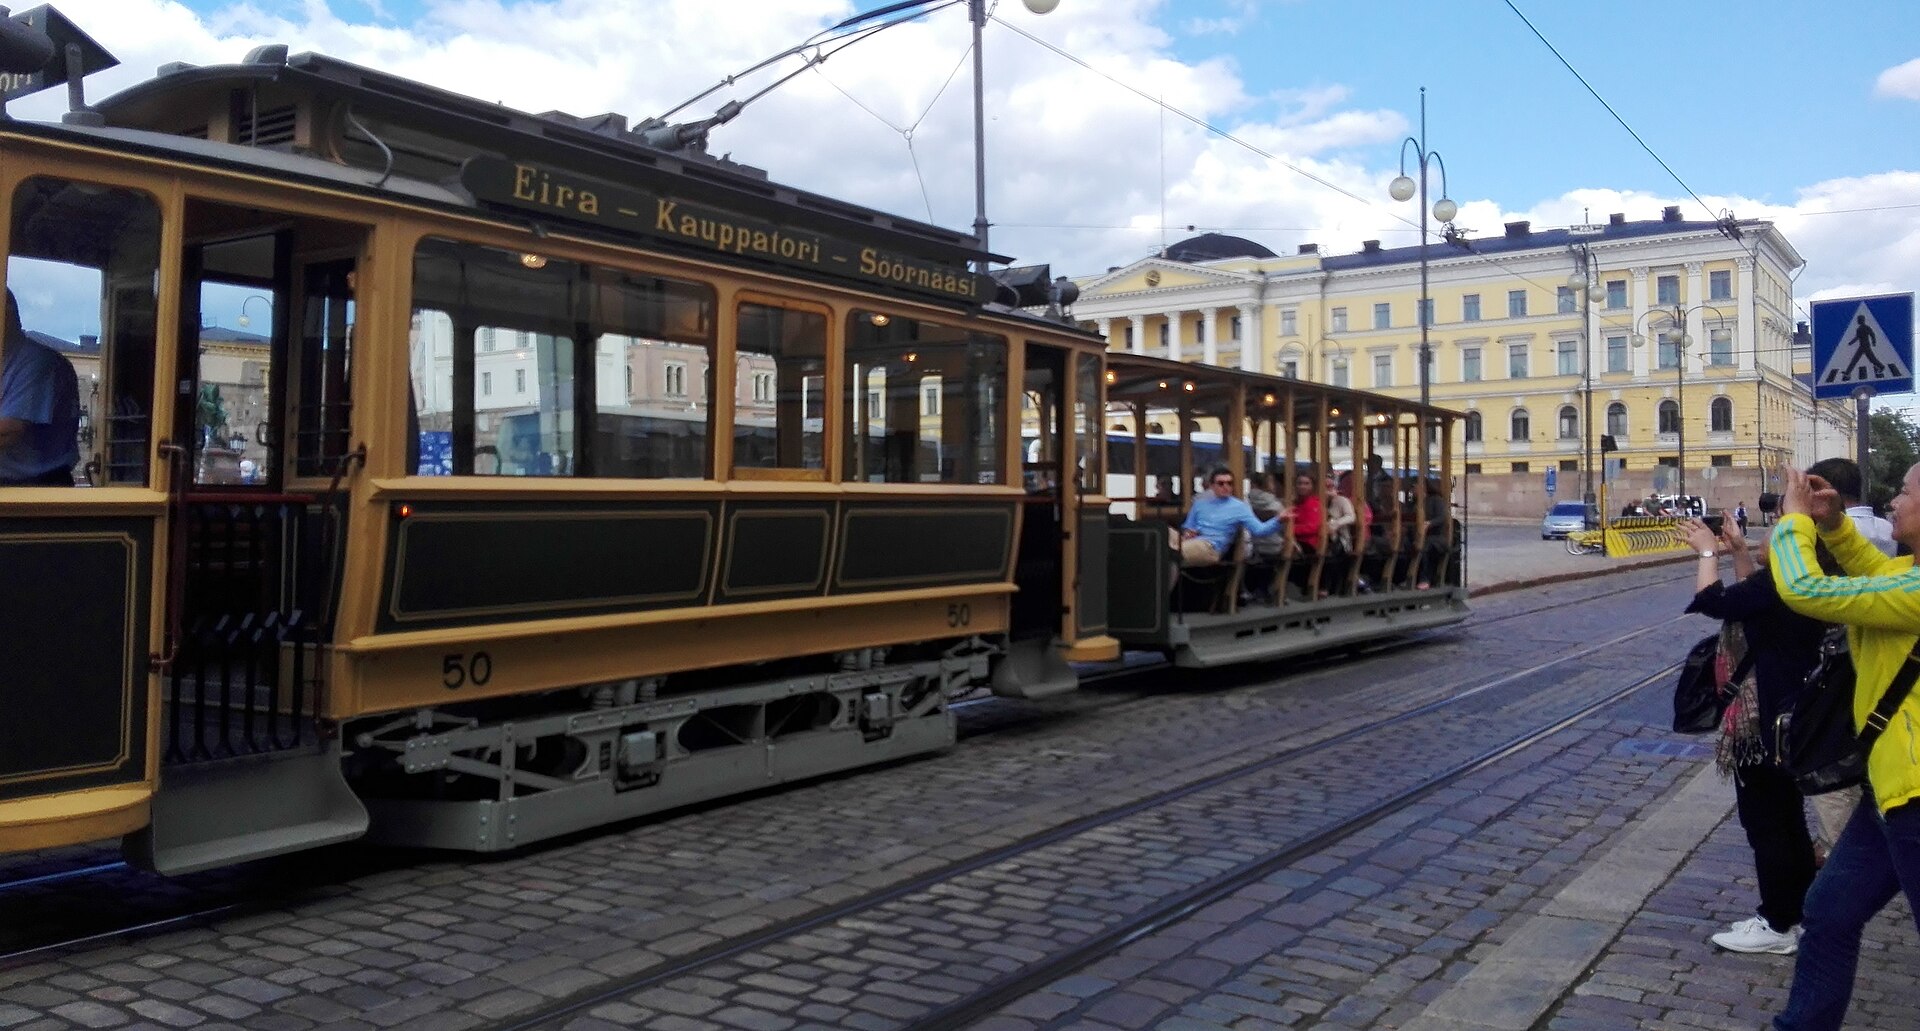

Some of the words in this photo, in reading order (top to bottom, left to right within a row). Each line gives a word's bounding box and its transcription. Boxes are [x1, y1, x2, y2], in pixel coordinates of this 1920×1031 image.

[513, 164, 599, 216] Eira
[656, 199, 820, 264] Kauppatori
[947, 603, 970, 628] 50
[443, 651, 492, 690] 50
